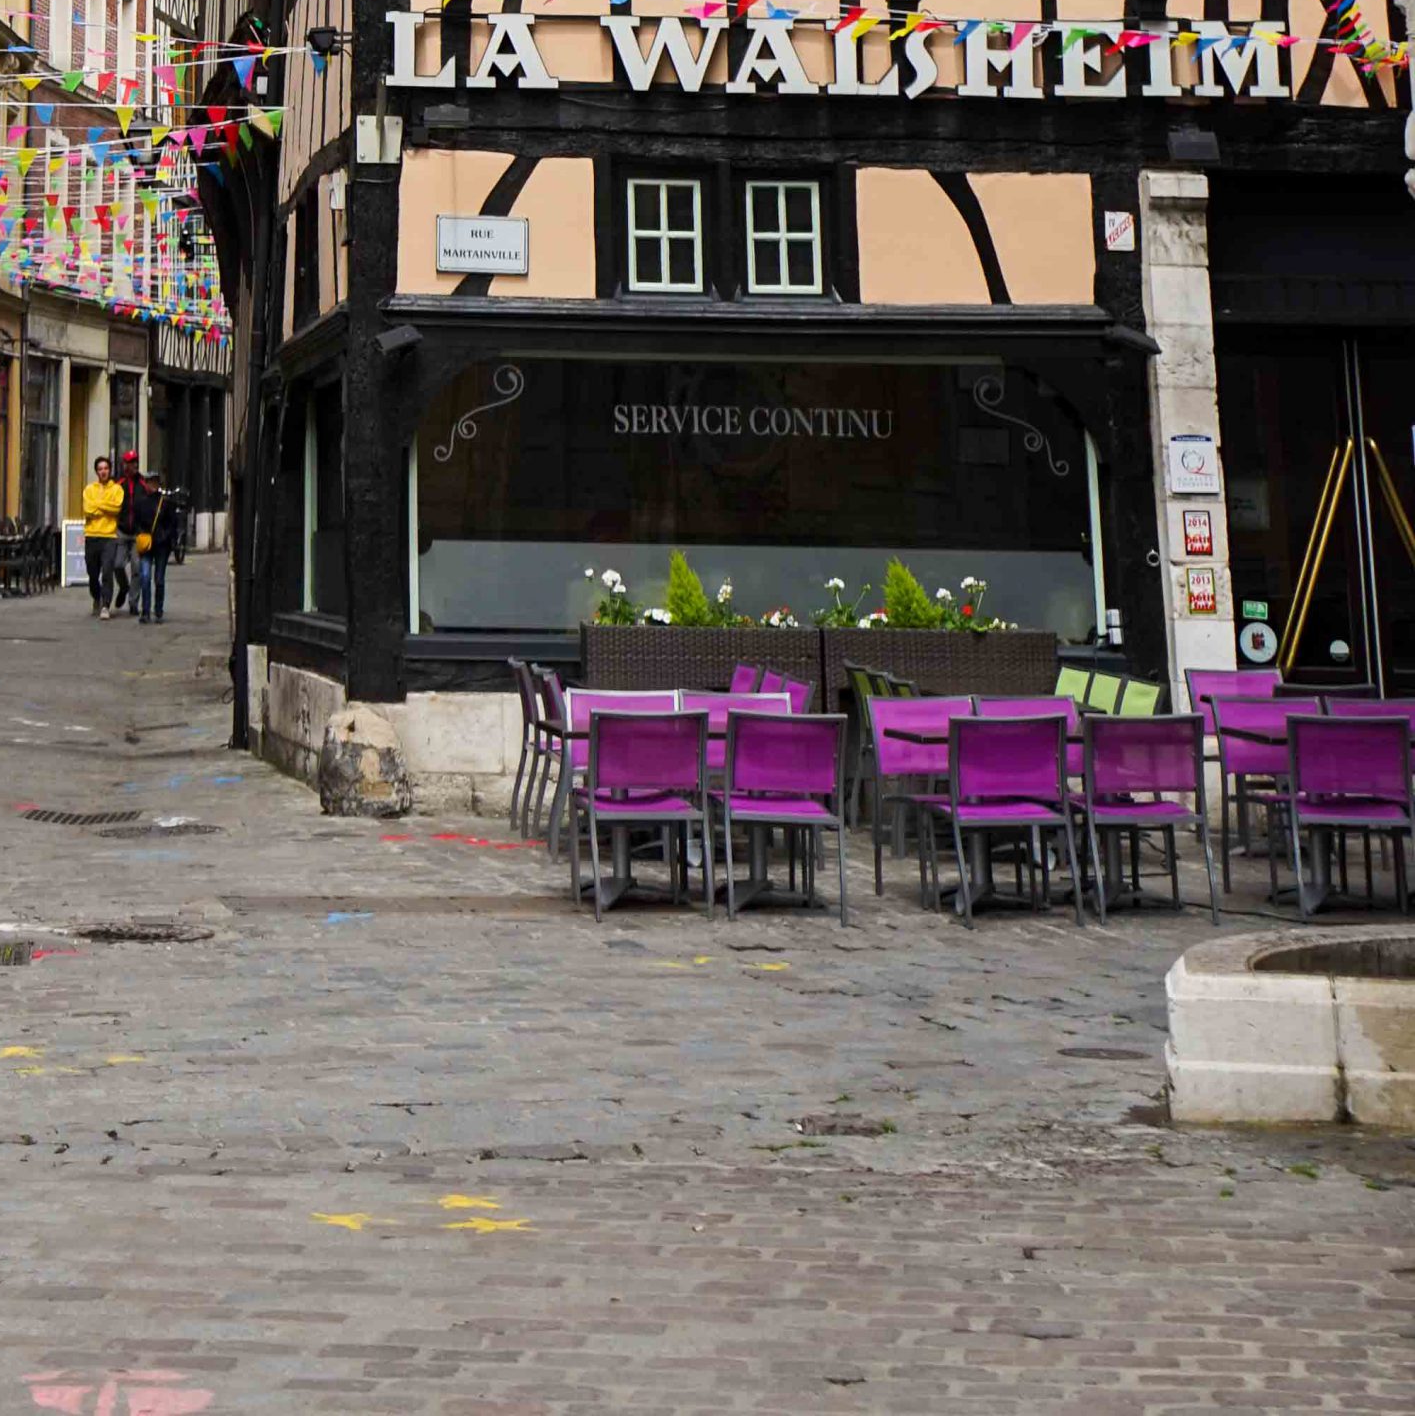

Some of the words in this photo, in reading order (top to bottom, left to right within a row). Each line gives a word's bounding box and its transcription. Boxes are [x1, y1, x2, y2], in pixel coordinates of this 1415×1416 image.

[385, 11, 559, 89] LA
[600, 15, 1290, 100] WALSHEIM
[470, 229, 495, 239] RUE
[443, 248, 521, 261] MARTAINVILLE
[613, 404, 742, 434] SERVICE
[748, 406, 894, 439] CONTINU
[1188, 518, 1207, 527] 2014
[1191, 576, 1211, 585] 2013
